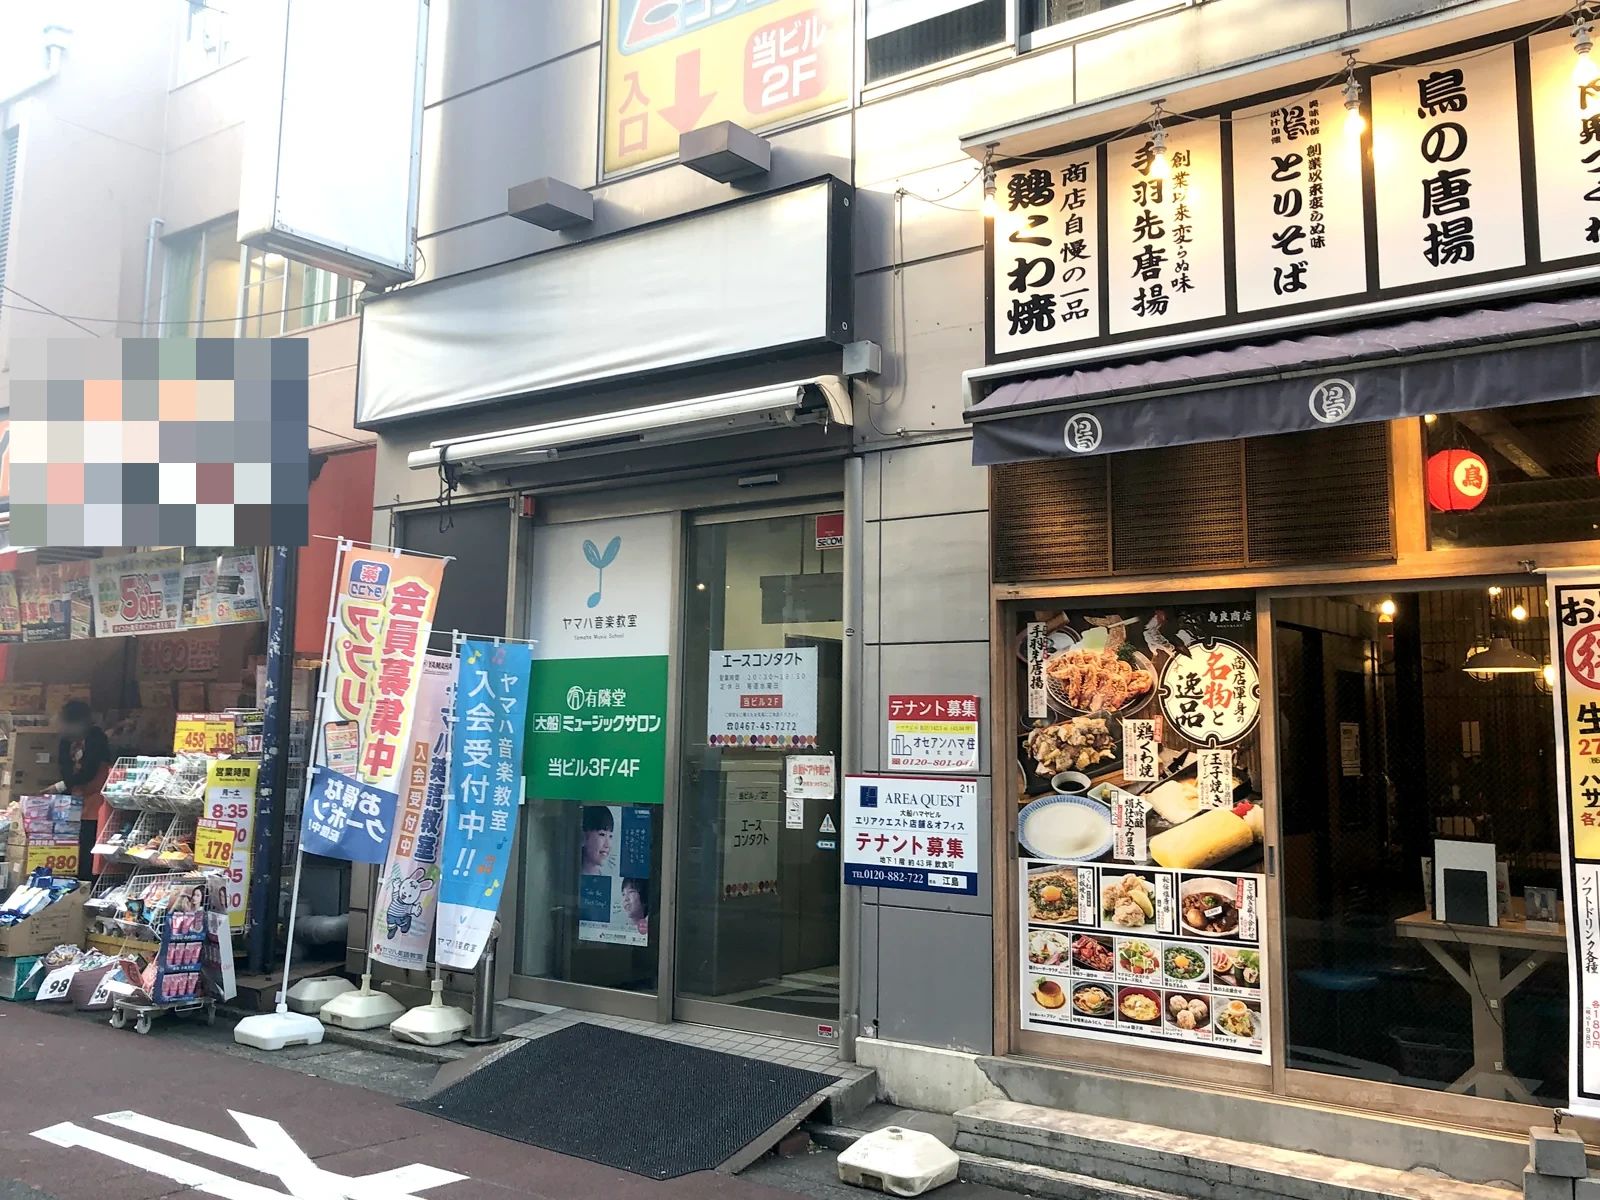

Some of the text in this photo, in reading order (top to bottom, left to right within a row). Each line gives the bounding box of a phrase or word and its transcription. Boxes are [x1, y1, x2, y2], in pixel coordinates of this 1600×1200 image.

[752, 16, 825, 69] 当ビル
[761, 56, 819, 107] 2F
[619, 71, 650, 158] 入口
[1418, 68, 1475, 267] 鳥の唐揚
[1131, 142, 1169, 317] 手羽先唐揚
[1271, 152, 1309, 295] とりそば
[1060, 162, 1091, 323] 商店自慢の一品
[817, 536, 843, 547] SECOM
[562, 614, 637, 630] ヤマハ音楽教室
[722, 652, 803, 668] エースコンタクト
[1202, 652, 1233, 726] 名物と
[585, 689, 627, 709] 有隣堂
[1175, 671, 1205, 728] 逸品
[890, 700, 977, 719] テナント募集
[536, 715, 662, 733] 大船 ミュージックサロン
[185, 731, 206, 748] 458
[215, 731, 234, 748] 198
[490, 673, 519, 832] ヤマハ音楽教室
[1137, 721, 1155, 778] 鶏くわ焼
[216, 767, 251, 778] 営業時間
[548, 758, 641, 777] 当ビル3F/4F
[960, 784, 976, 794] 211
[400, 743, 428, 856] 入会受付中
[885, 792, 964, 809] AREA QUEST
[212, 803, 249, 818] 8:35
[741, 819, 763, 831] エース
[733, 833, 770, 847] コンタクト
[856, 832, 966, 859] テナント募集
[205, 840, 231, 861] 178
[45, 855, 78, 870] 880
[1582, 876, 1599, 974] ソフトドリンク各種
[49, 978, 71, 994] 98
